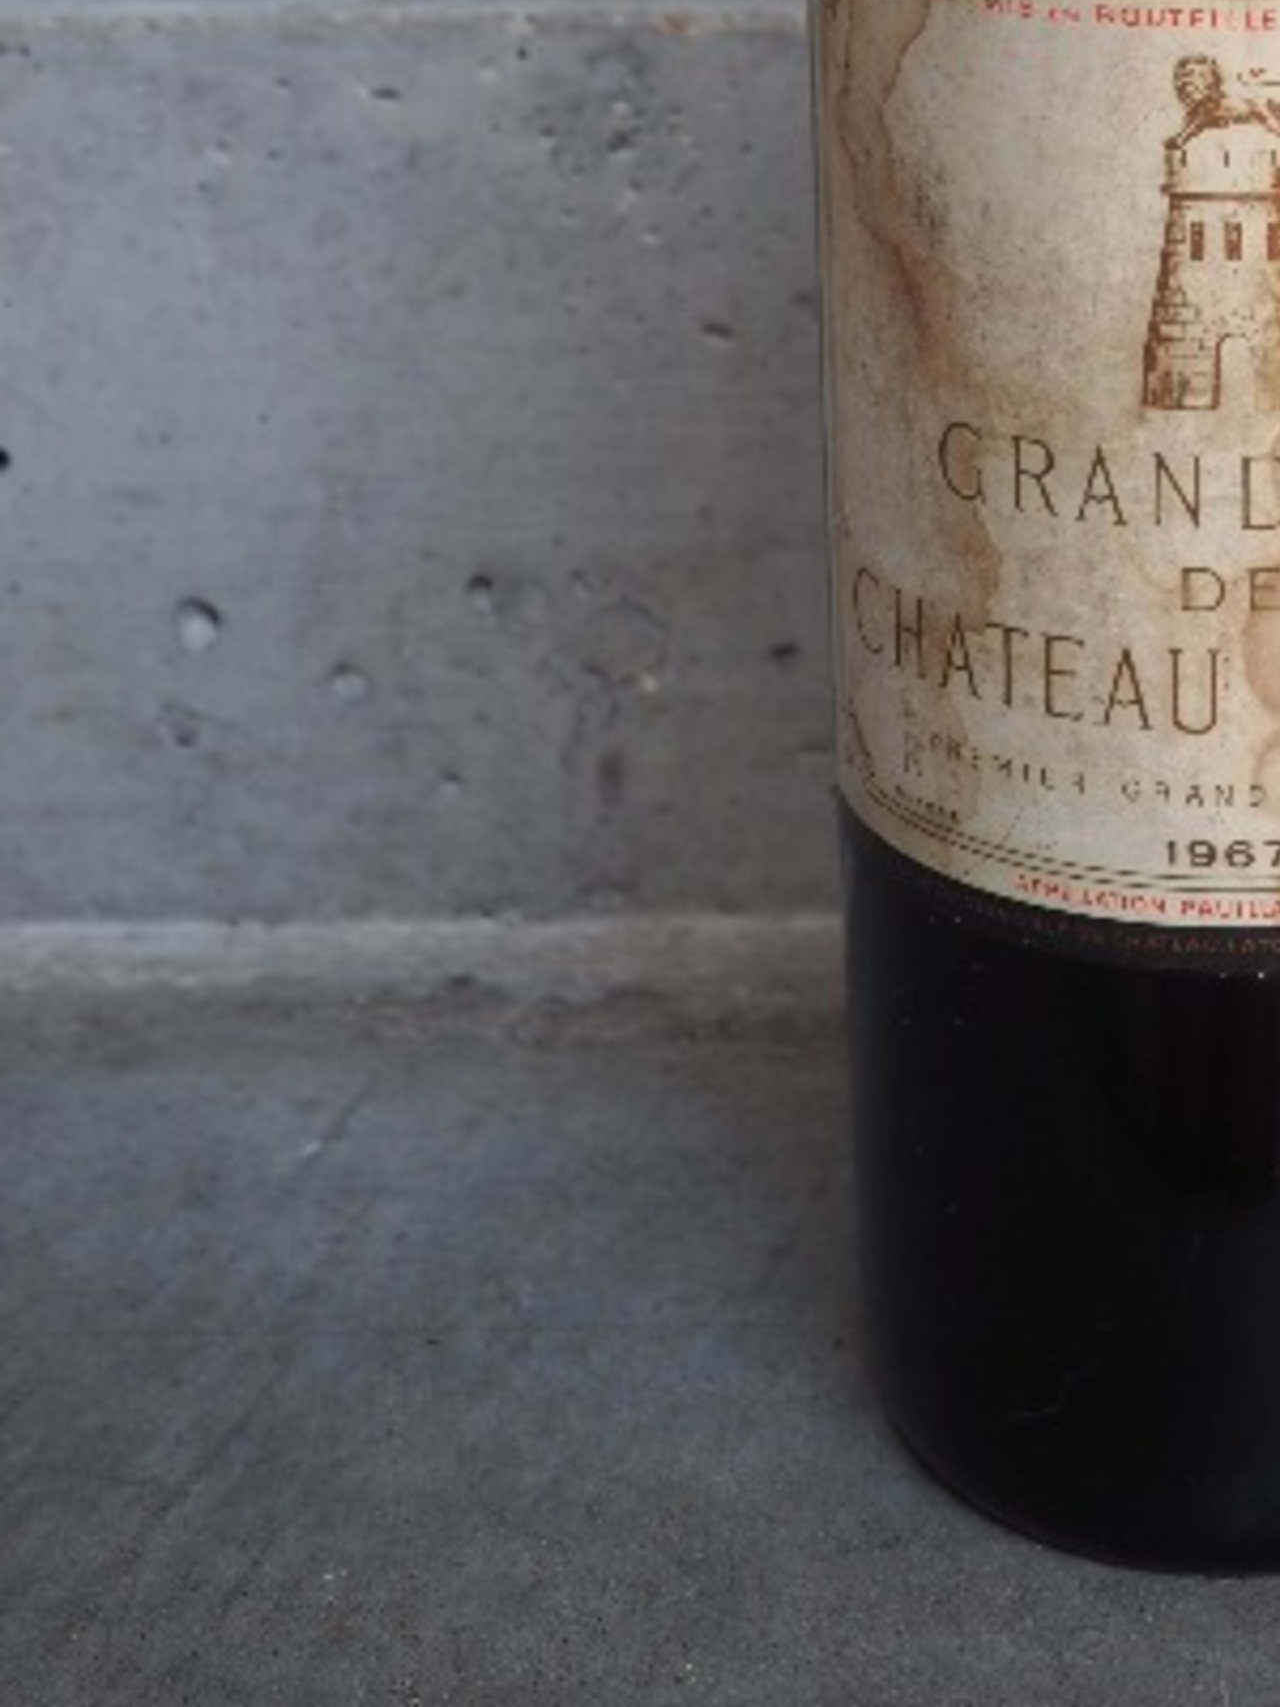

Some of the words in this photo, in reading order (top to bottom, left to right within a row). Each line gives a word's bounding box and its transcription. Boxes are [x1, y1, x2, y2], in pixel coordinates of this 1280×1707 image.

[852, 566, 1220, 736] CHATEAU
[1120, 779, 1268, 808] GRAND
[1015, 873, 1167, 916] APPELATION
